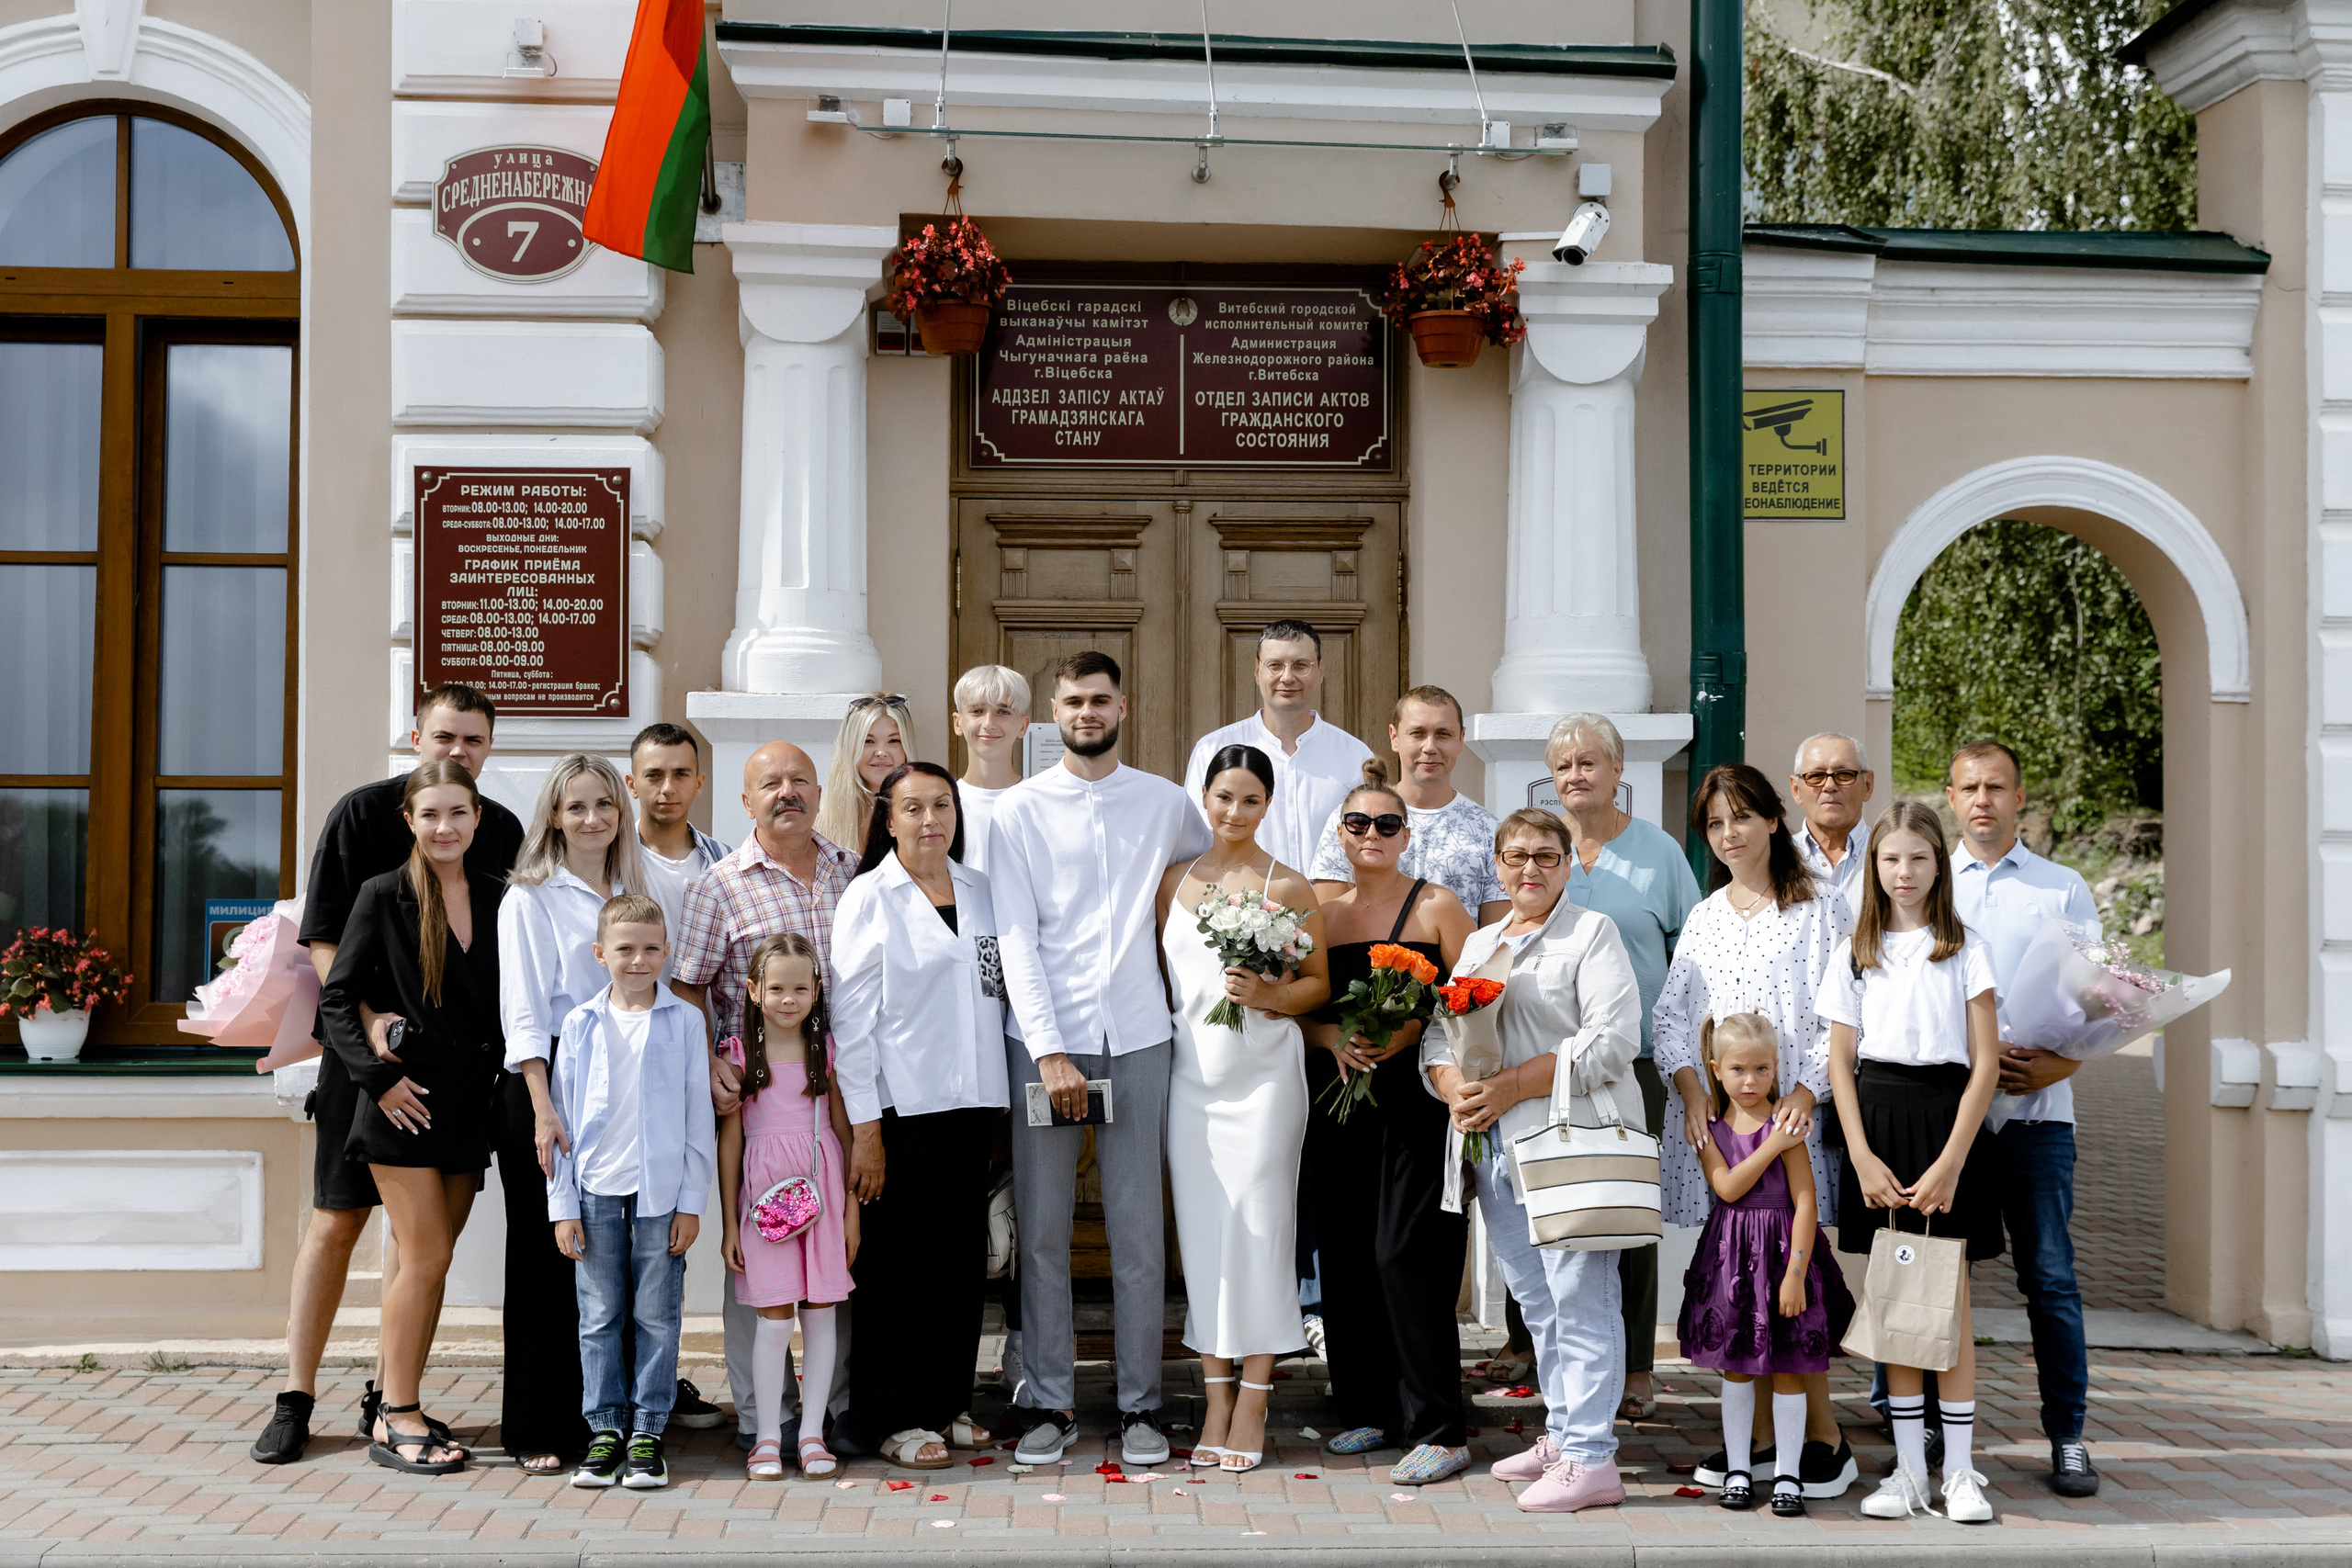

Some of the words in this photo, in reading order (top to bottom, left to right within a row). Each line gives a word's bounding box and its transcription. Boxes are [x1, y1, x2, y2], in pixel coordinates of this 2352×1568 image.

[494, 153, 552, 169] улица
[442, 171, 593, 212] СРЕДНЕНАБЕРЕЖН
[508, 221, 538, 262] 7
[1008, 299, 1069, 312] Віцебскі
[1079, 301, 1140, 314] гарадскі
[1219, 302, 1284, 313] Витебский
[1292, 304, 1355, 316] городской
[1001, 316, 1085, 330] выканаўчы
[1093, 317, 1148, 328] камітэт
[1205, 319, 1313, 330] исполнительный
[1320, 321, 1369, 330] комитет
[1016, 334, 1131, 349] Адміністрацыя
[1231, 337, 1336, 351] Администрация
[1000, 350, 1097, 365] Чыгуначнага
[1105, 352, 1148, 365] раёна
[1193, 353, 1321, 367] Железнодорожного
[1329, 354, 1373, 367] района
[1035, 367, 1112, 379] г.Віцебска
[1250, 369, 1318, 380] г.Витебска
[992, 389, 1048, 406] АДДЗЕЛ
[1059, 389, 1110, 404] ЗАПІСУ
[1119, 387, 1164, 405] АКТАЎ
[1195, 391, 1244, 408] ОТДЕЛ
[1252, 392, 1312, 406] ЗАПИСИ
[1320, 392, 1369, 407] АКТОВ
[1012, 410, 1144, 427] ГРАМАДЗЯНСКАГА
[1222, 412, 1343, 429] ГРАЖДАНСКОГО
[1056, 431, 1101, 446] СТАНУ
[1237, 433, 1329, 447] СОСТОЯНИЯ
[1749, 465, 1836, 476] ТЕРРИТОРИИ
[461, 485, 514, 496] РЕЖИМ
[522, 486, 586, 496] РАБОТЫ:
[1753, 479, 1808, 494] ВЕДЁТСЯ
[534, 502, 587, 513] 14.00-20.00
[1745, 498, 1840, 511] ЕОНАБЛЮДЕНИЕ
[555, 518, 605, 529] 14.00-17.00
[458, 545, 522, 553] ВОСКРЕСЕНЬЕ,
[465, 559, 518, 570] ГРАФИК
[525, 558, 580, 570] ПРИЁМА
[450, 573, 594, 583] ЗАИНТЕРЕСОВАННЫХ
[507, 587, 538, 597] ЛИЦ:
[442, 601, 479, 609] ВТОРНИК:
[543, 599, 603, 610] 14.00-20.00
[442, 615, 469, 624] СРЕДА:
[538, 613, 595, 624] 14.00-17.00
[442, 629, 476, 637] ЧЕТВЕРГ:
[478, 626, 538, 637] 08.00-13.00
[481, 641, 544, 652] 08.00-09.00
[442, 658, 478, 666] СУББОТА:
[480, 655, 543, 666] 08.00-09.00
[492, 670, 521, 679] Пятница,
